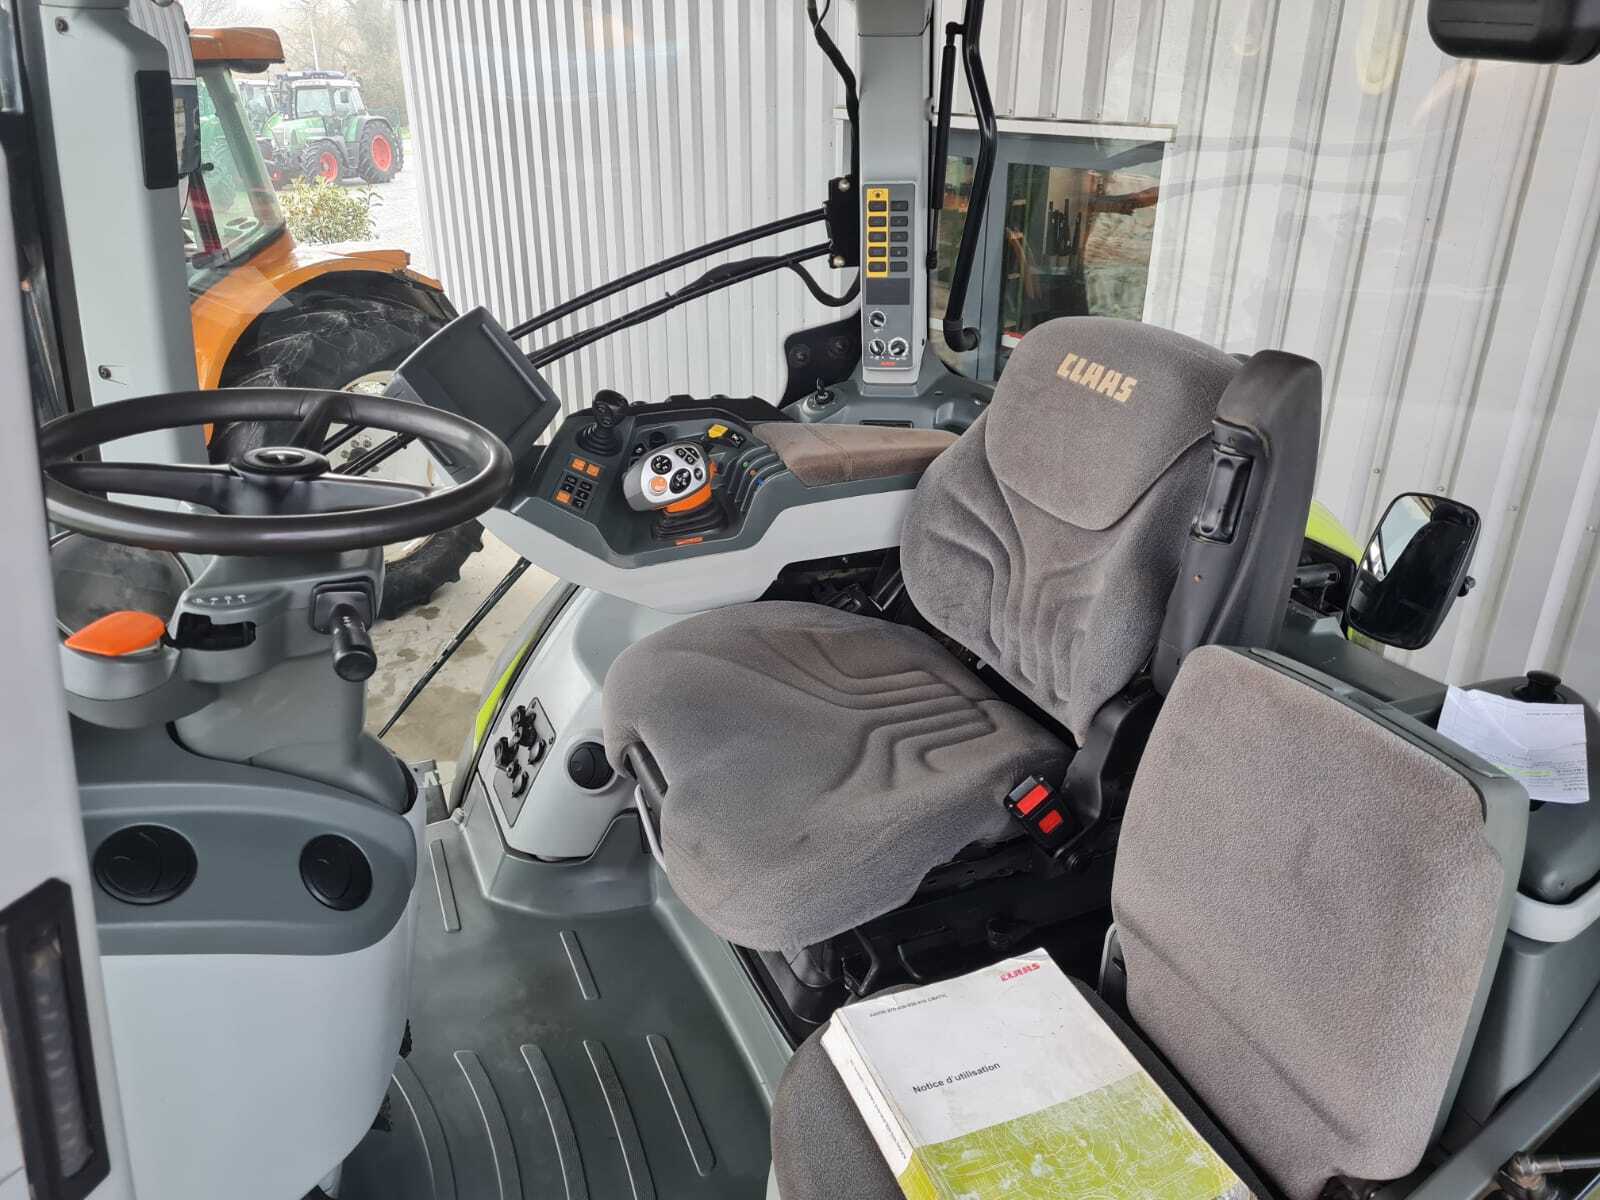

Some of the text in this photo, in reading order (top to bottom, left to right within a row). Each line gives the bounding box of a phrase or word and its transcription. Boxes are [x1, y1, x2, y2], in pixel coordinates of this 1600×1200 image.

[1057, 352, 1138, 402] CLAAS
[1001, 963, 1041, 981] CLAAS
[912, 1080, 944, 1094] Notice
